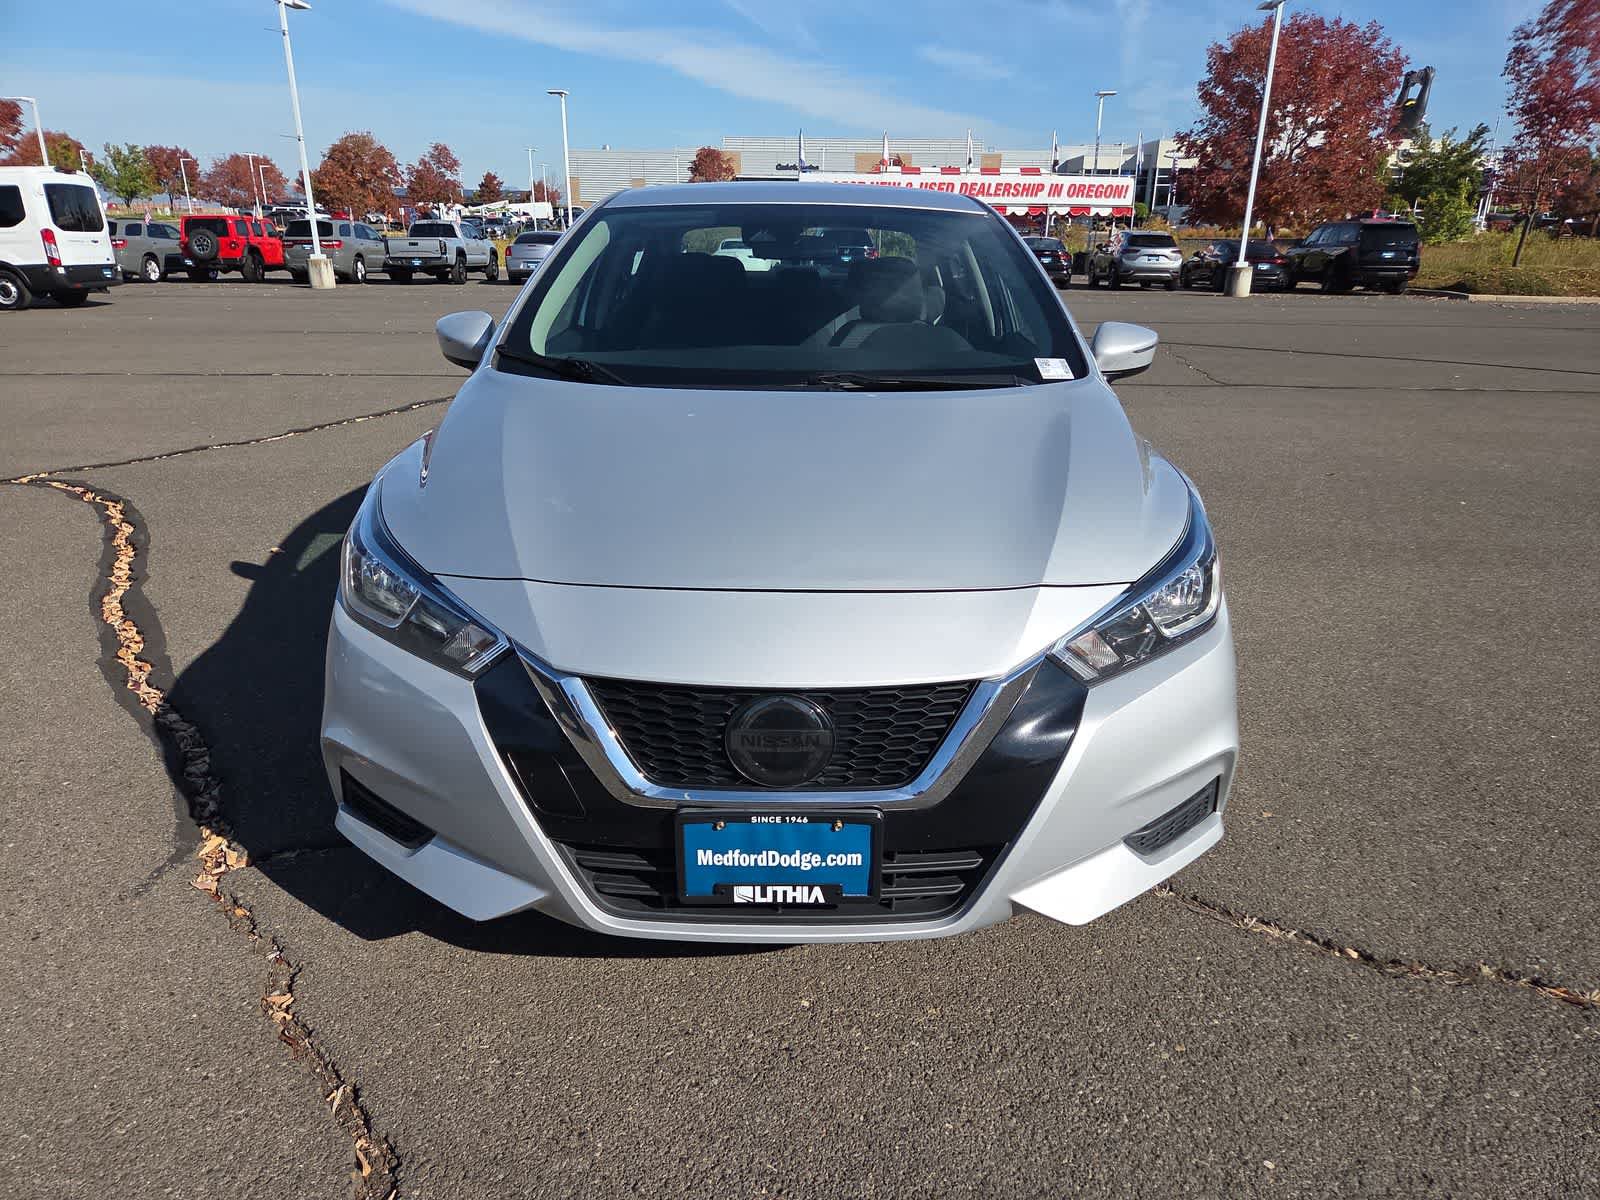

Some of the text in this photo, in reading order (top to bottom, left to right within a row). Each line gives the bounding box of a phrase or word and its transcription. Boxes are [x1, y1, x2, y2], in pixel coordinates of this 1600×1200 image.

[959, 182, 1045, 198] DEALERSHIP
[1048, 183, 1064, 198] IN
[1066, 184, 1130, 199] OREGON!
[742, 734, 819, 749] NISSAN
[751, 816, 809, 824] SINCE 1946
[697, 849, 862, 871] MedfordDodge.com
[754, 885, 826, 903] LITHIA
